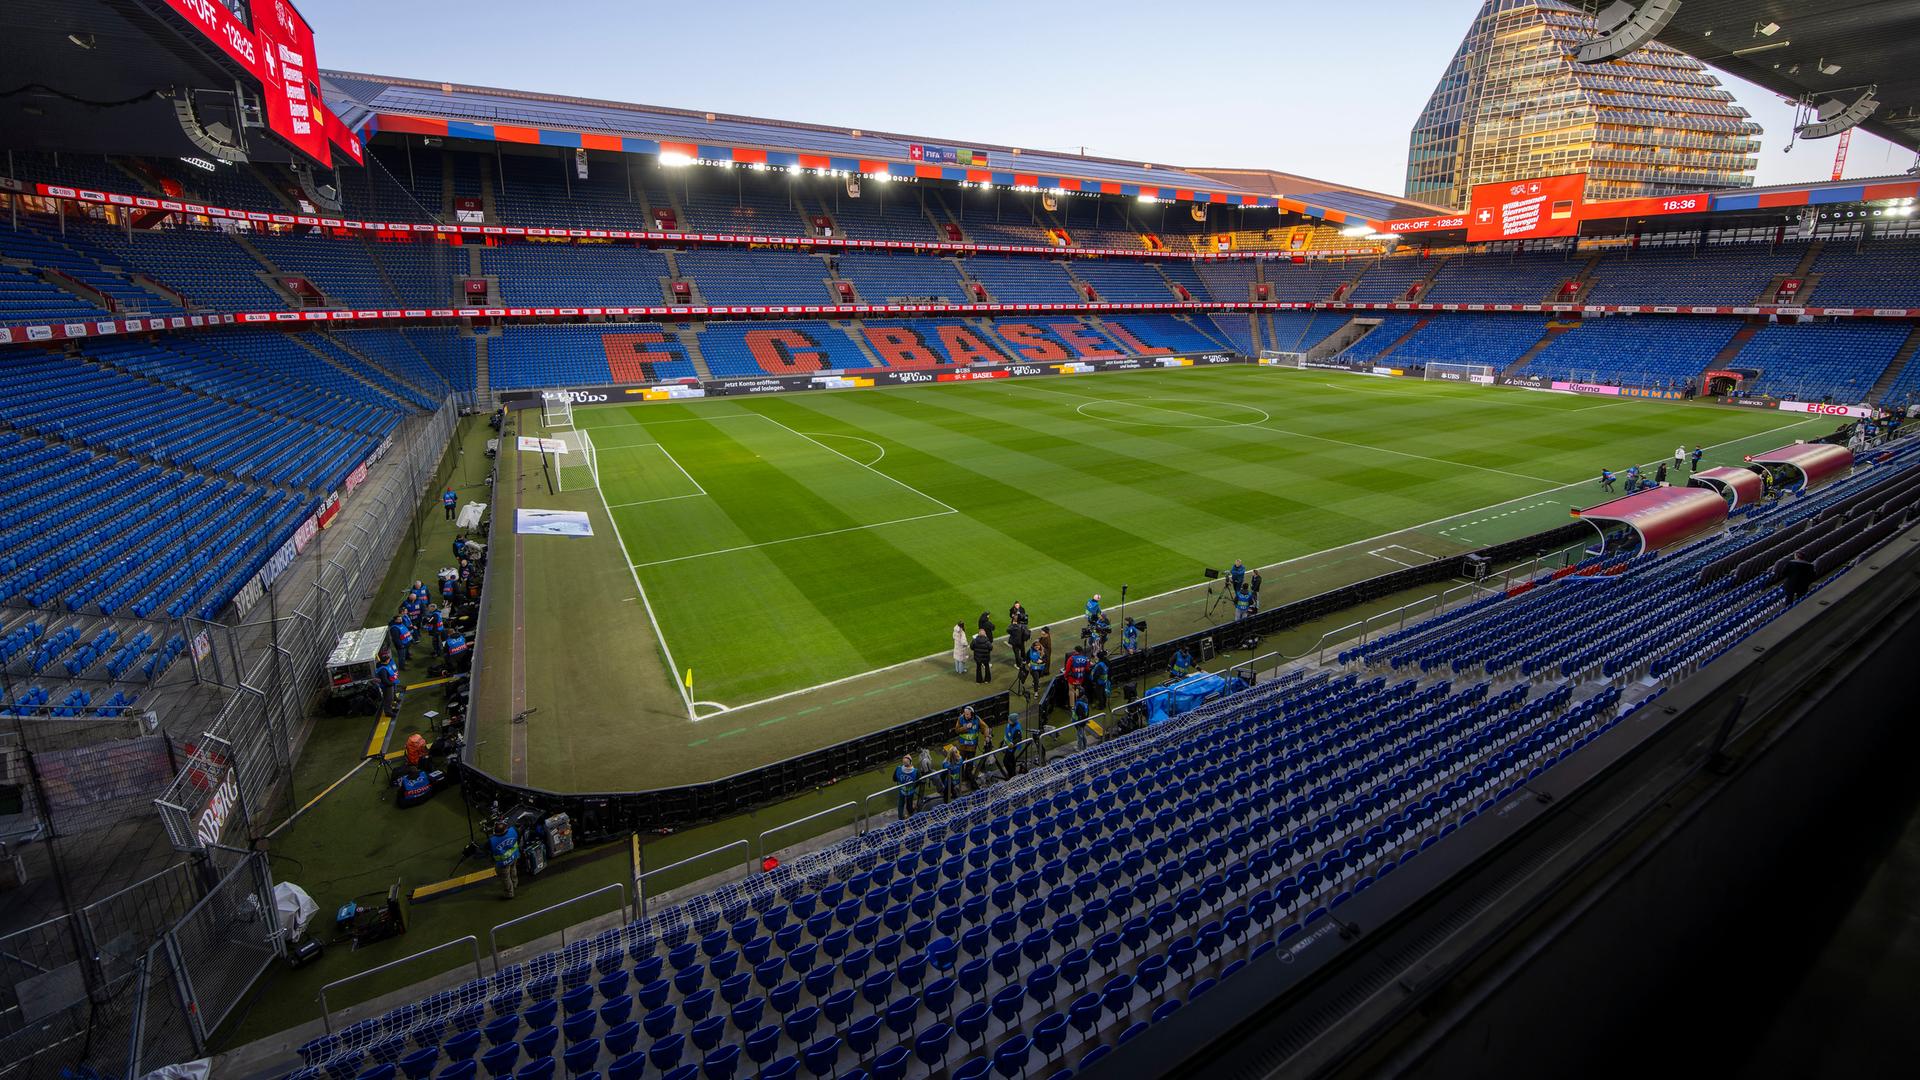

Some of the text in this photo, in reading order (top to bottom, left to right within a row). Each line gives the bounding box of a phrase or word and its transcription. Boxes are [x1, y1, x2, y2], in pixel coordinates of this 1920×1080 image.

[222, 21, 256, 65] -128:25
[926, 150, 940, 158] FIFA
[1502, 195, 1547, 212] Willkommen
[1502, 203, 1540, 217] Bienvenue
[1663, 199, 1696, 211] 18:36
[1502, 210, 1539, 224] Benvenuti
[1391, 218, 1464, 231] KICK-OFF -128:25
[1503, 223, 1537, 236] Welcome
[601, 322, 1176, 384] F C BASEL
[972, 371, 994, 379] BASEL
[1513, 378, 1541, 387] bitvavo
[1568, 382, 1600, 393] Klarna
[1806, 403, 1849, 415] ERGO
